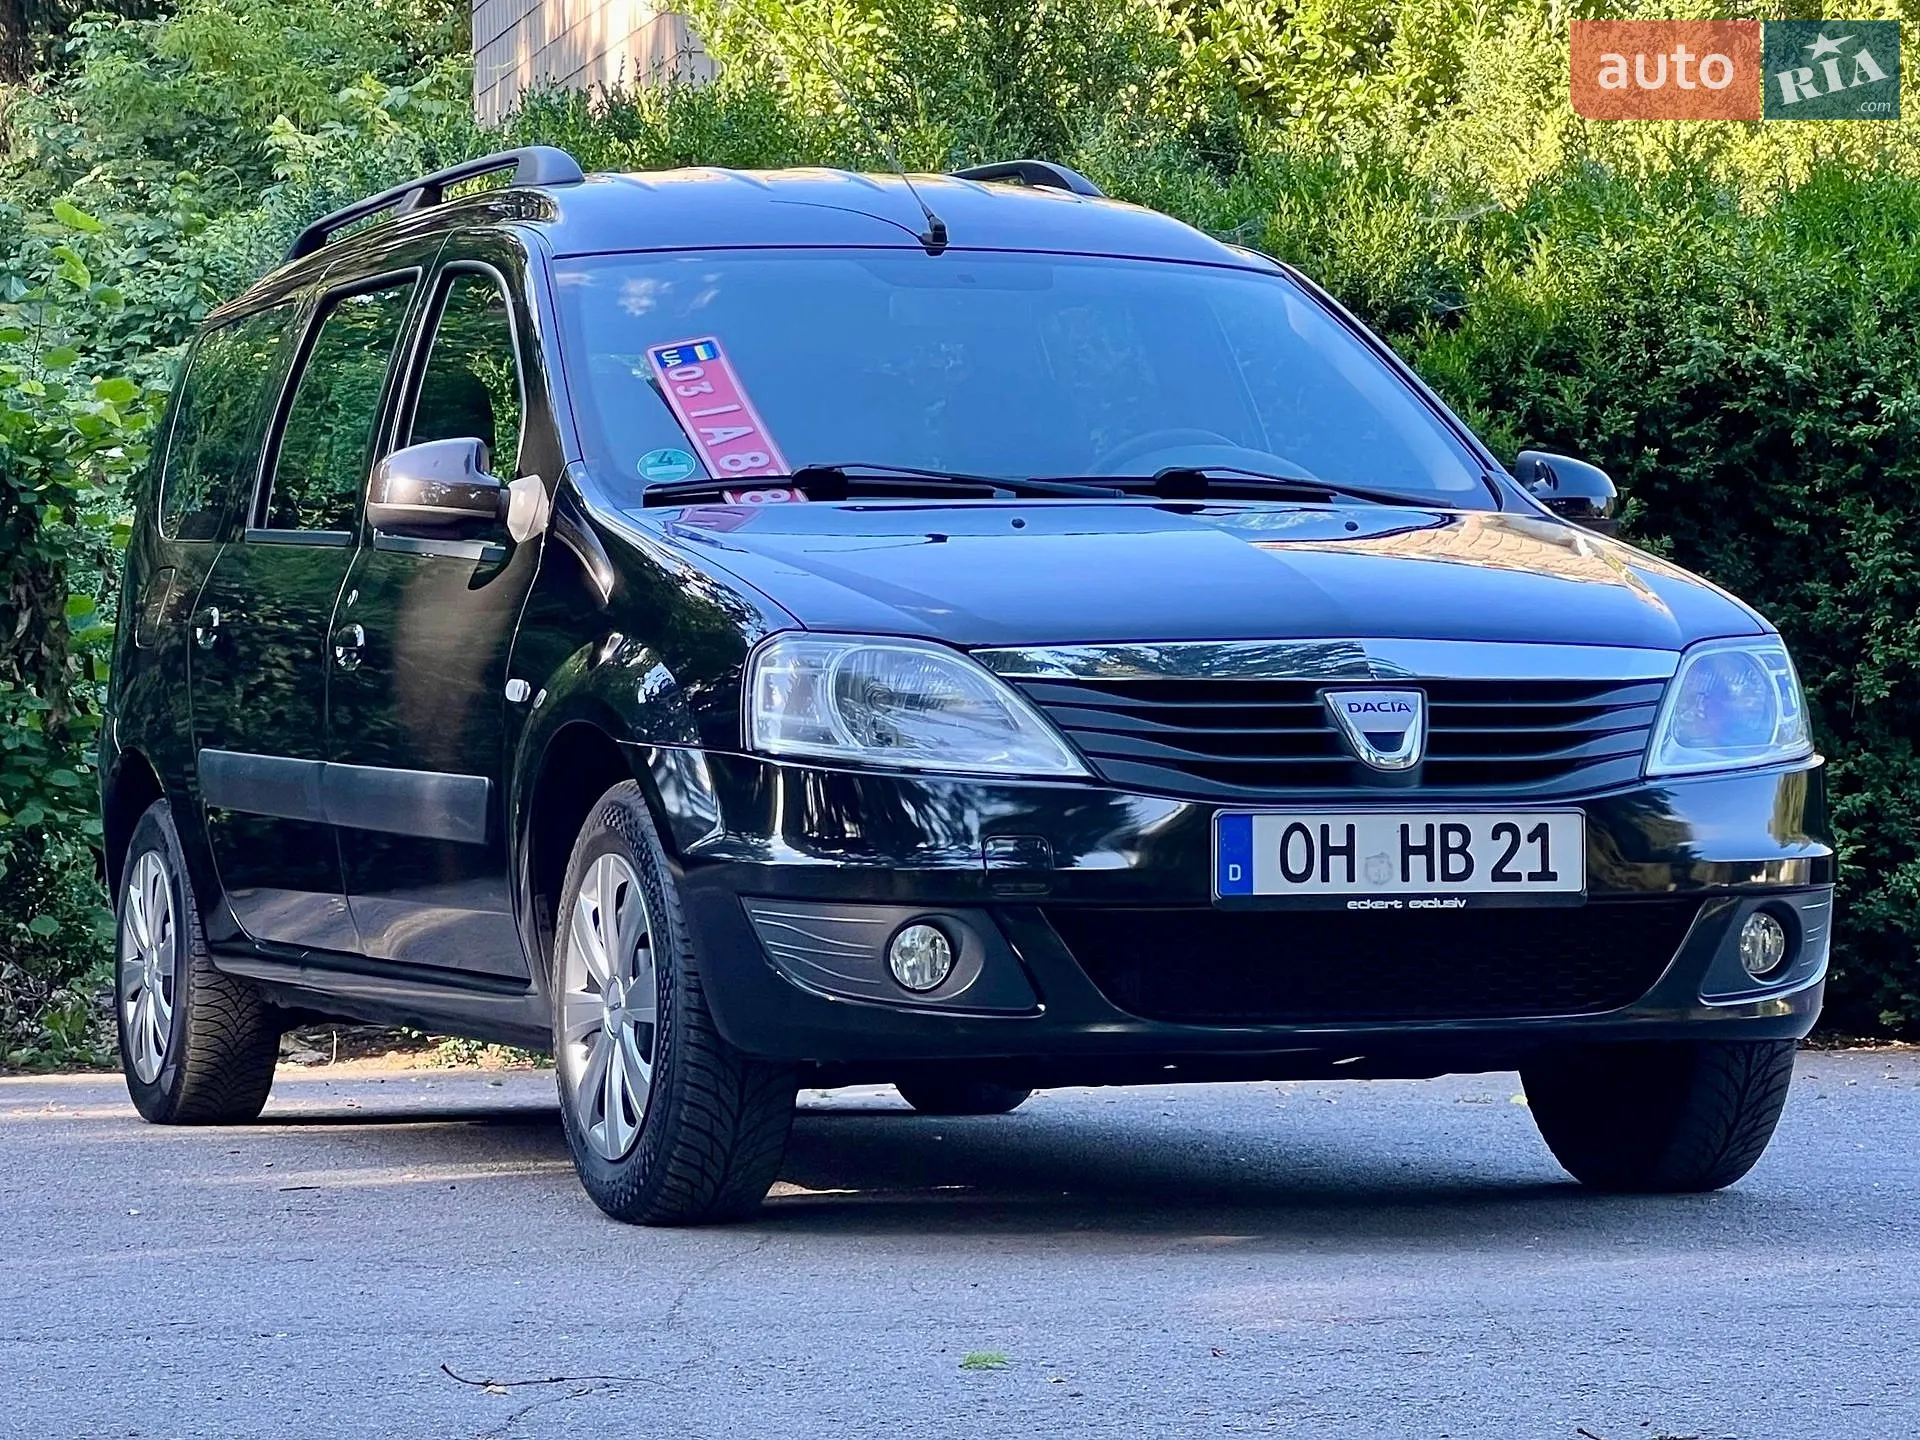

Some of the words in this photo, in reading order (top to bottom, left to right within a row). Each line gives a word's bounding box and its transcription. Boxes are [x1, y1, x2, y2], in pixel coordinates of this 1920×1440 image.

[661, 349, 682, 368] UA
[668, 366, 715, 398] 03
[690, 404, 754, 446] IA
[658, 451, 674, 465] 4
[1347, 702, 1411, 713] DACIA
[1279, 822, 1356, 883] OH
[1400, 823, 1475, 883] HB
[1491, 822, 1558, 882] 21
[1228, 864, 1241, 881] D
[1346, 899, 1403, 909] eckert
[1408, 898, 1466, 908] exclusiv
